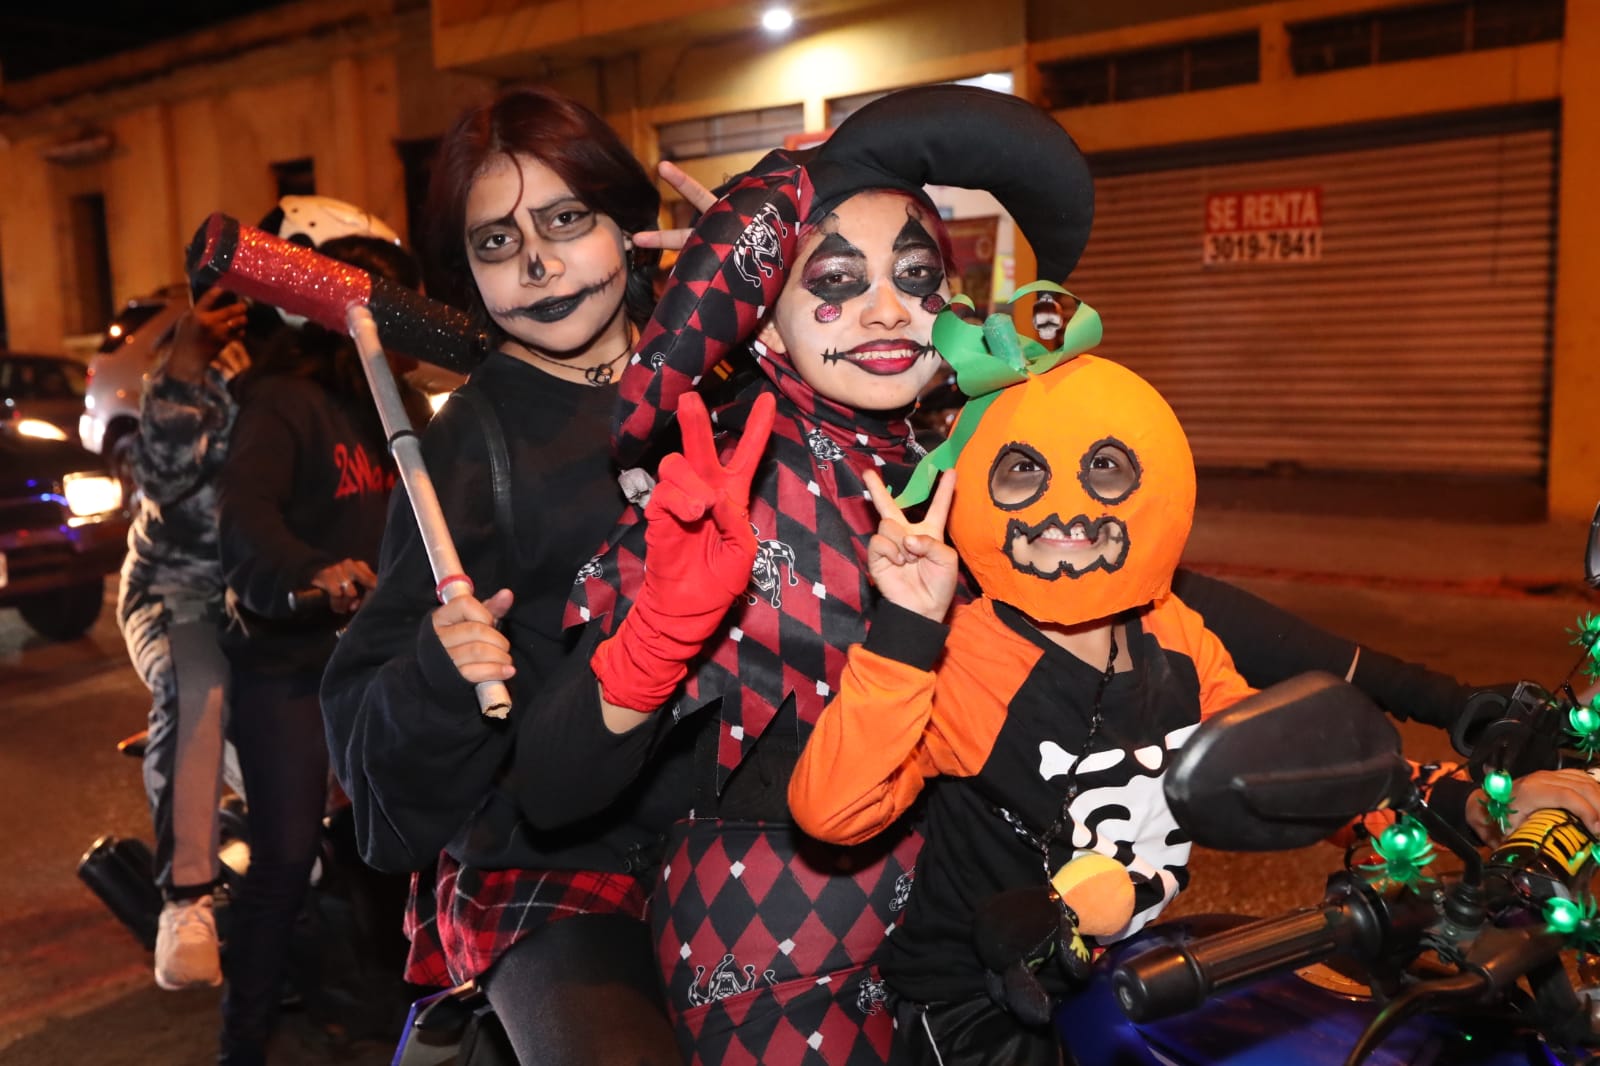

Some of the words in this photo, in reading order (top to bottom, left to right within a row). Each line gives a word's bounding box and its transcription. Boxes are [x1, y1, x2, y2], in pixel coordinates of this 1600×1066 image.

[1209, 196, 1237, 229] SE
[1243, 191, 1317, 226] RENTA
[1209, 231, 1317, 259] 3019-7841
